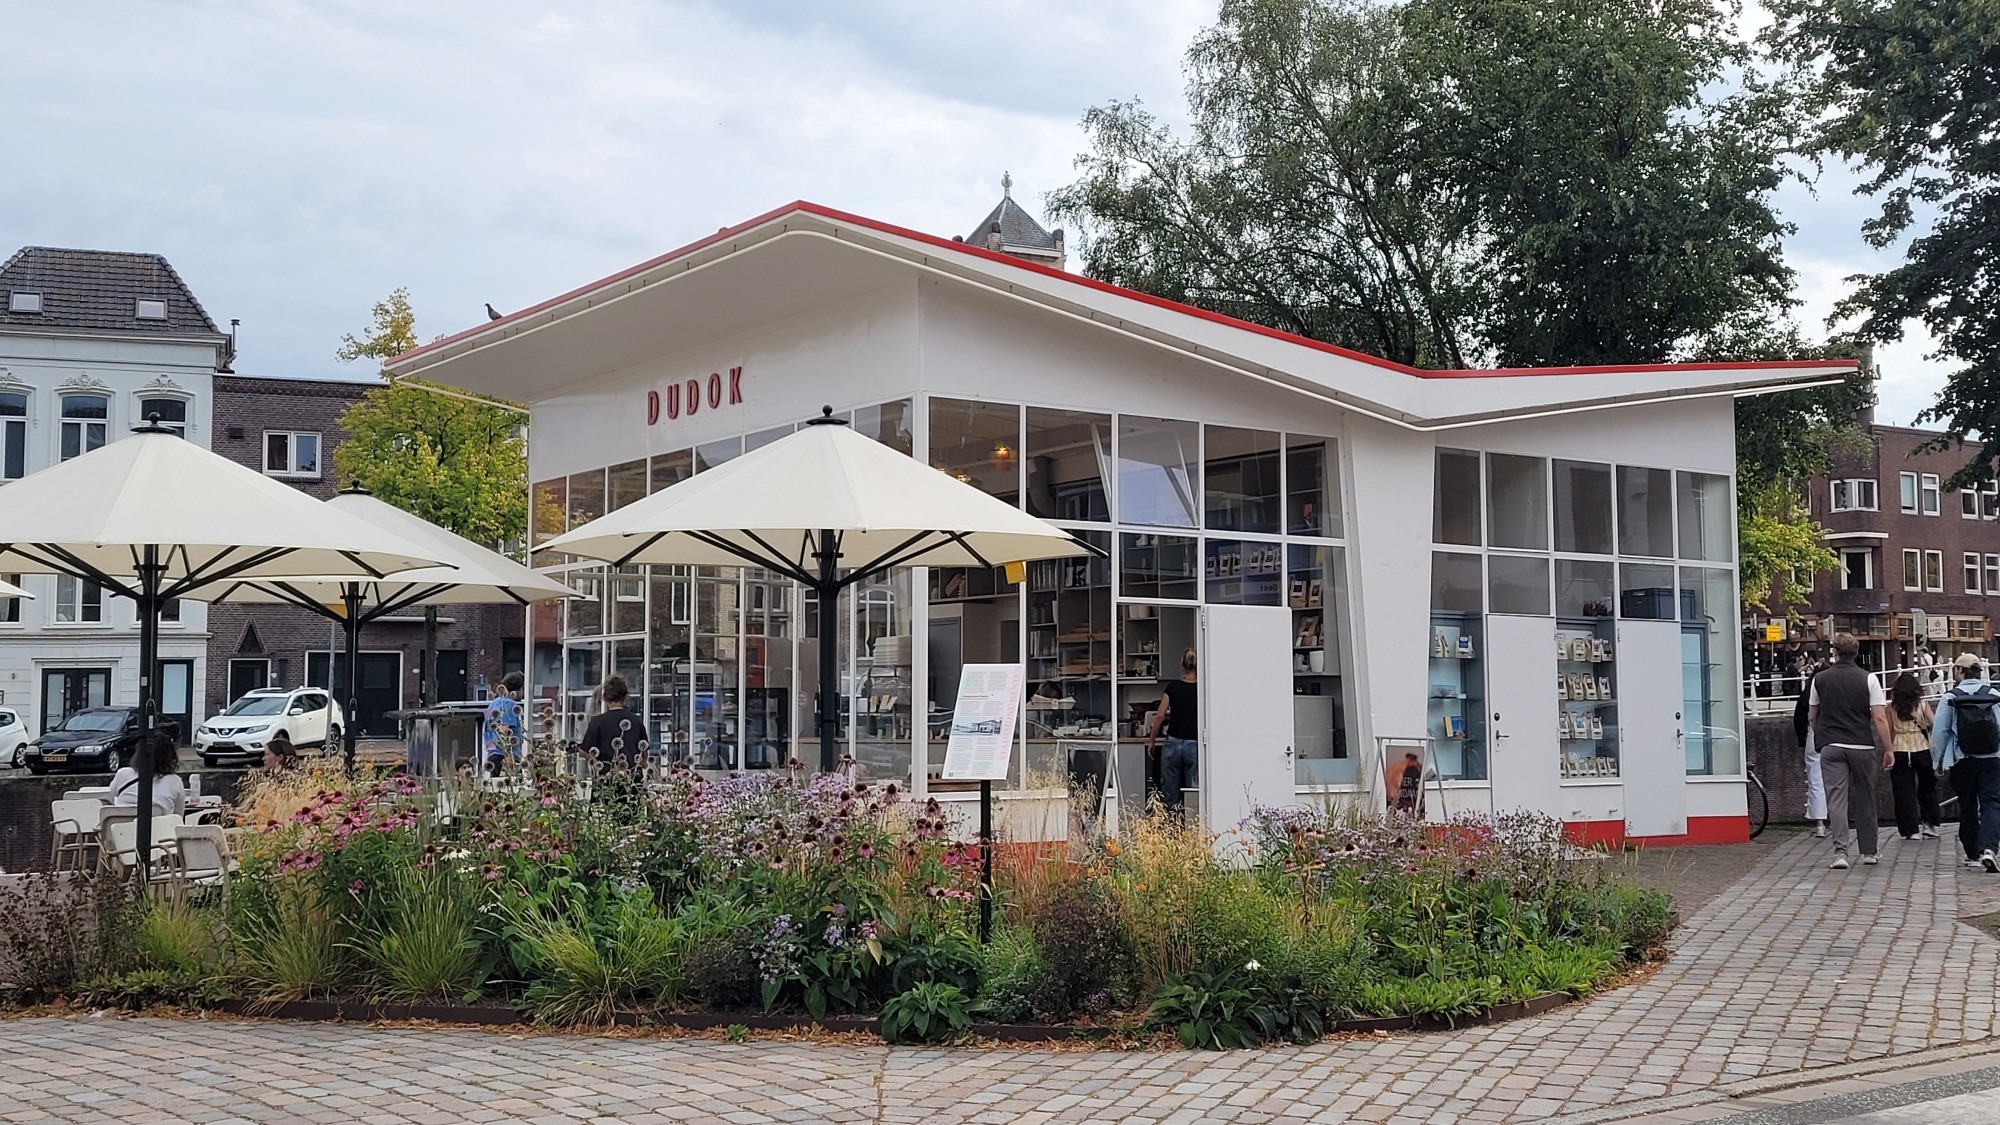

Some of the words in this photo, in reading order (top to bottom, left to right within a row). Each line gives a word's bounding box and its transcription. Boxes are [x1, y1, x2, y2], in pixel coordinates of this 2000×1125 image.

[647, 366, 742, 426] DUDOK
[11, 672, 16, 680] 9
[999, 666, 1024, 761] STADSMONUMENTEN
